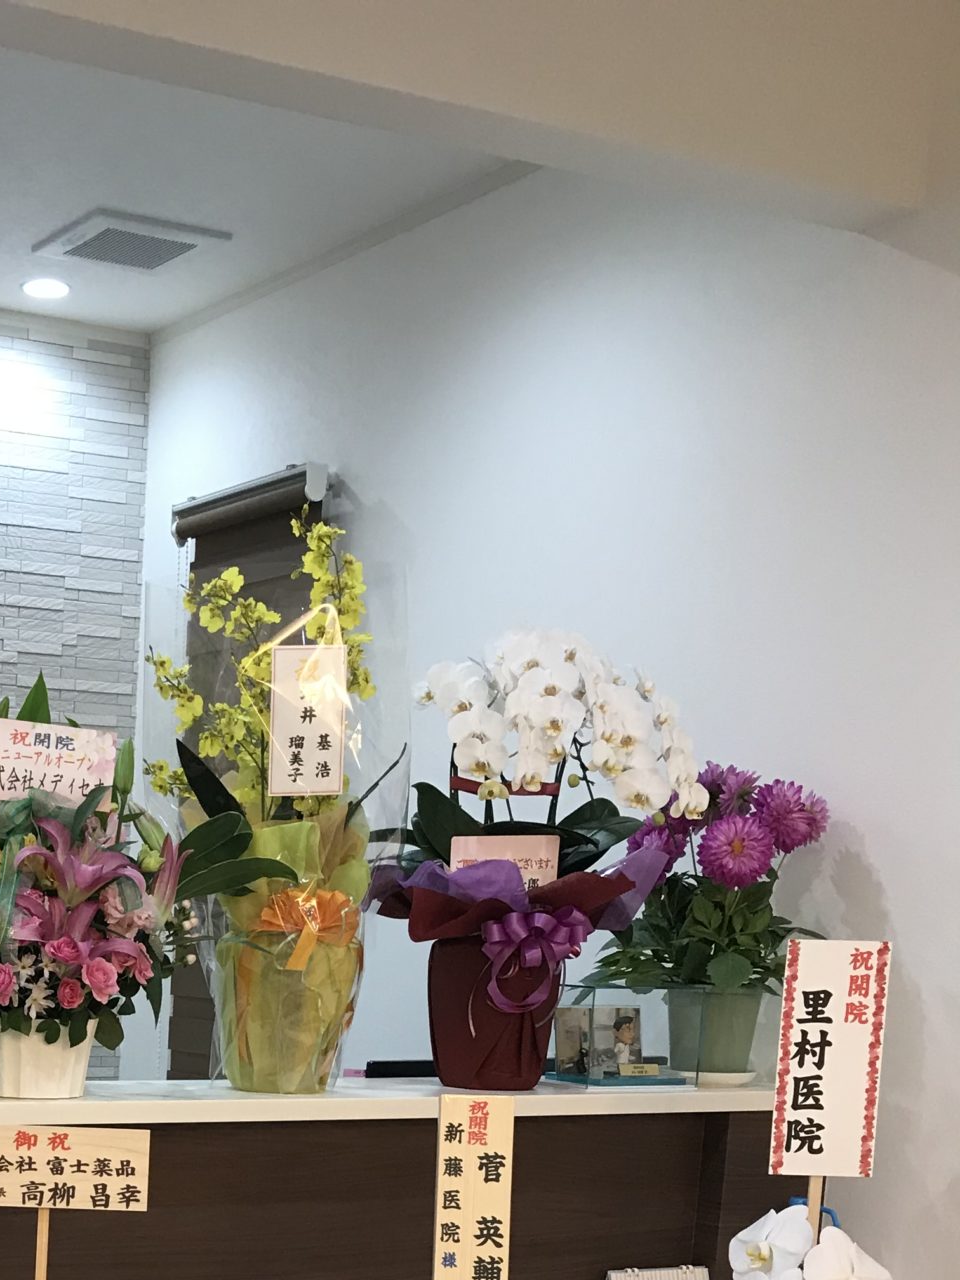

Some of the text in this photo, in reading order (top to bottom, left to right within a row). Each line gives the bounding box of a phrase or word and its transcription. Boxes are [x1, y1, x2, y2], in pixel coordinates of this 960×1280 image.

[9, 729, 76, 751] 祝開院
[288, 735, 305, 783] 瑠美子
[844, 948, 874, 1025] 祝開院
[784, 989, 834, 1155] 里村医院
[13, 1130, 72, 1151] 御祝
[467, 1101, 489, 1146] 祝開院
